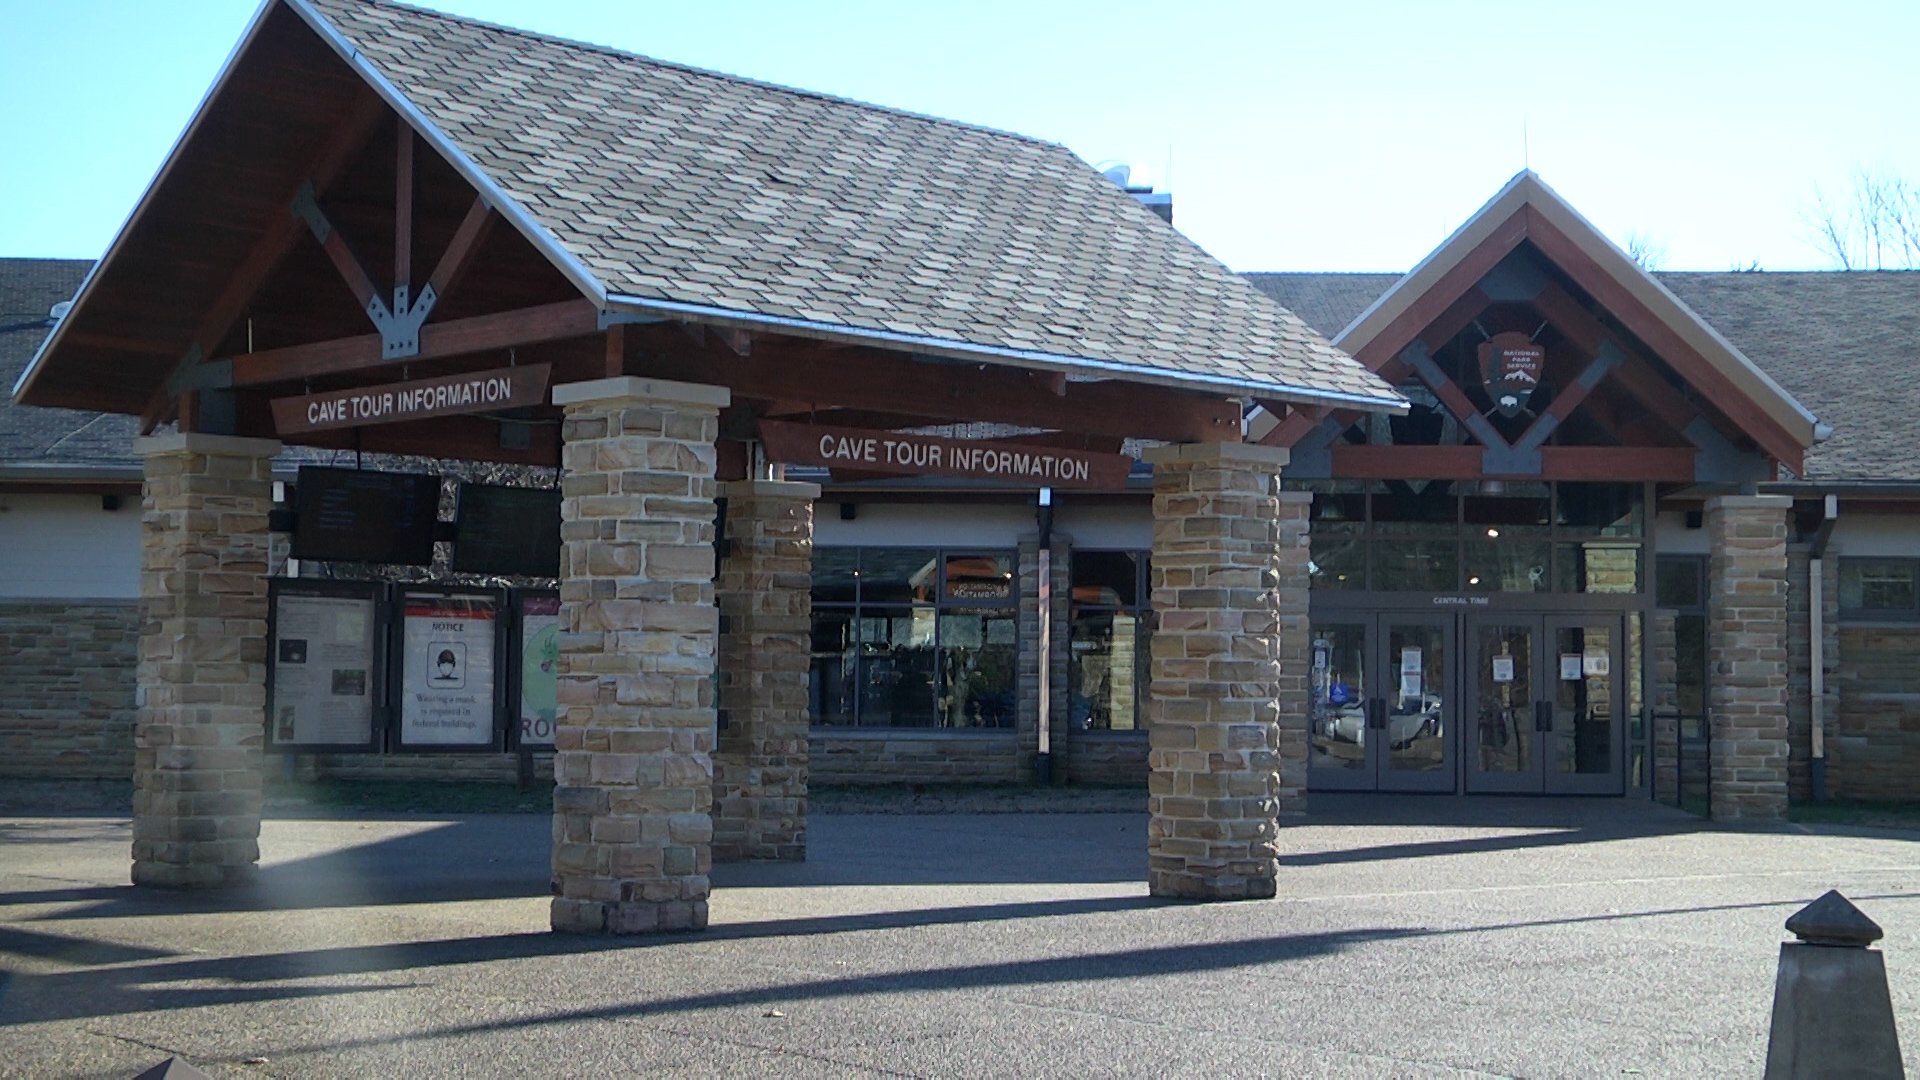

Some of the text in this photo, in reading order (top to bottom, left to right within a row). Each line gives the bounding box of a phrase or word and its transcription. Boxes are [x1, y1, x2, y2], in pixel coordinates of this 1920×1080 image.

[307, 377, 511, 424] CAVE TOUR INFORMATION
[820, 434, 1089, 481] CAVE TOUR INFORMATION
[432, 622, 464, 632] NOTICE
